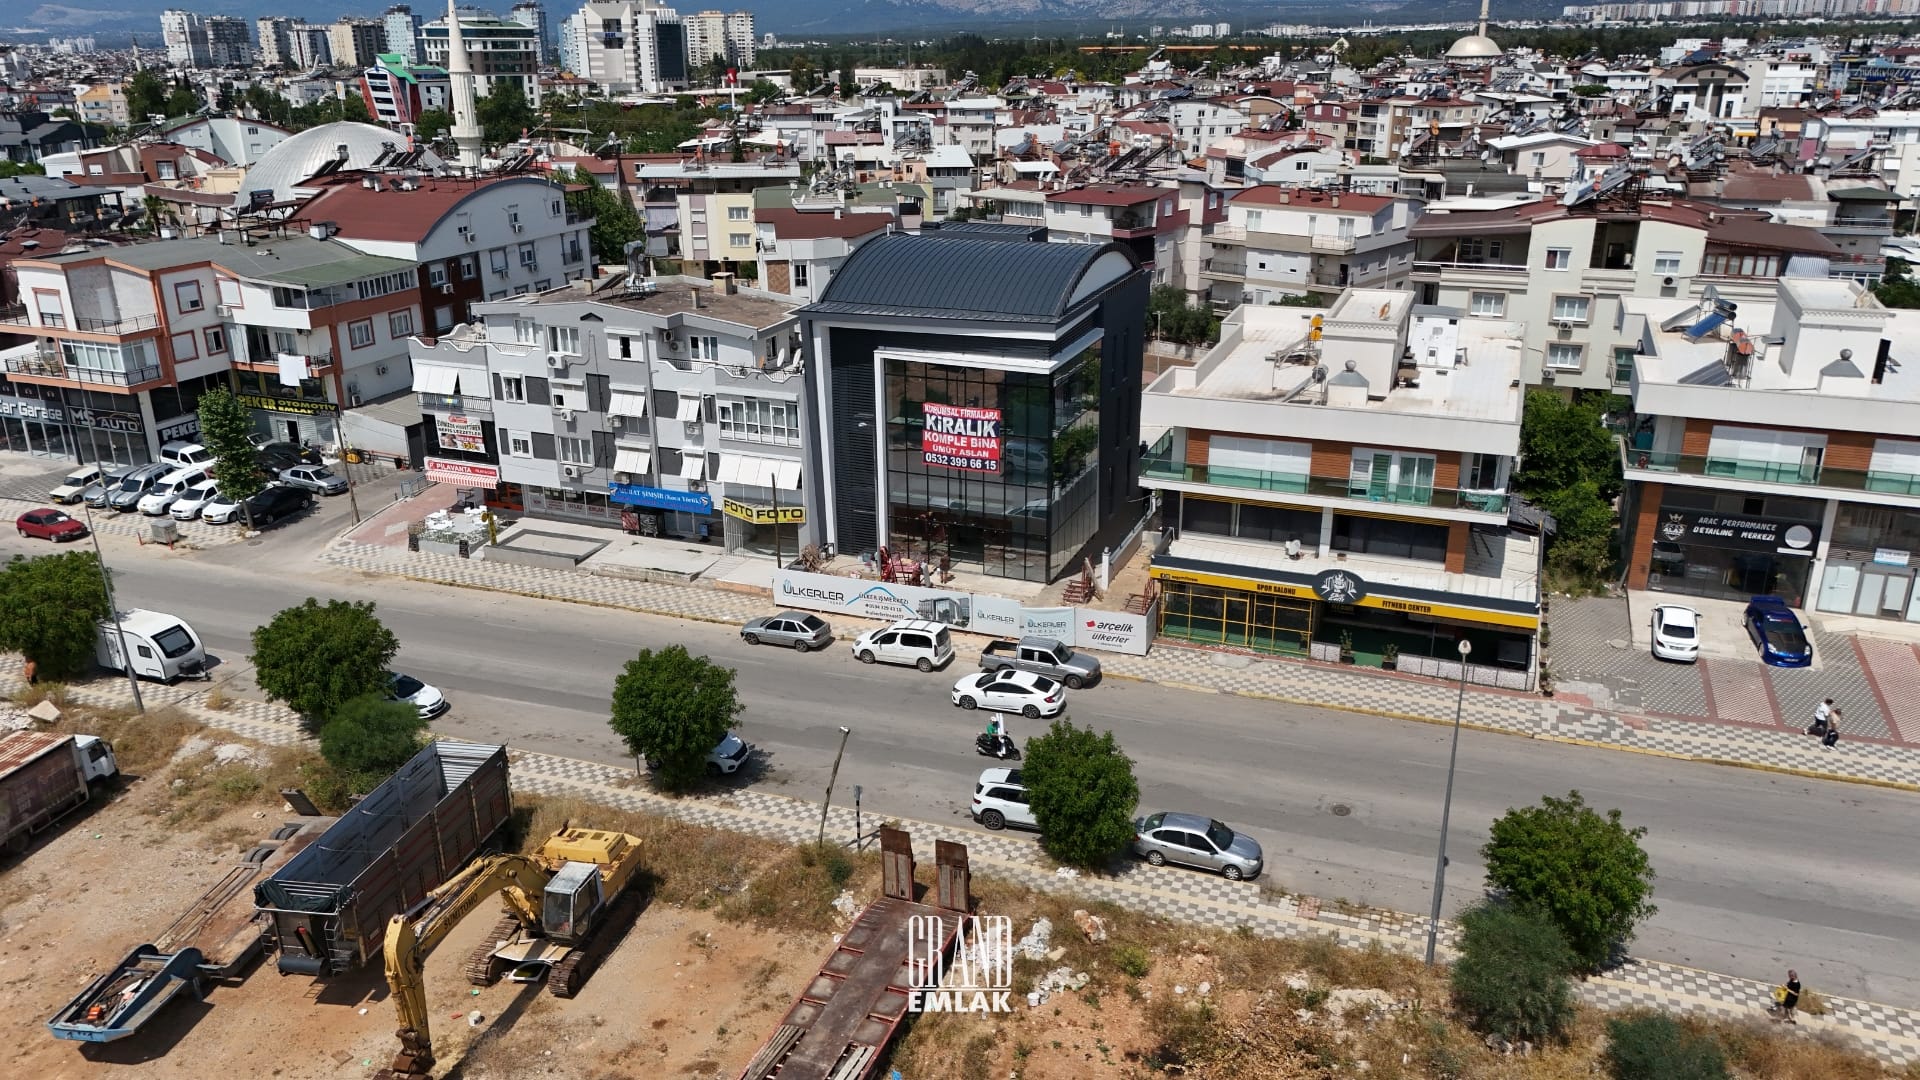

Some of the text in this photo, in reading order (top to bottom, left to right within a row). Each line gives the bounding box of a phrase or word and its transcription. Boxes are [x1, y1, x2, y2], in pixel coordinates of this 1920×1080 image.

[19, 402, 62, 420] Garage
[70, 408, 95, 426] MS
[101, 418, 140, 431] AUTO
[924, 431, 967, 446] KOMPLE
[959, 448, 989, 457] ASLAN
[925, 452, 996, 470] 0532 399 66 15
[724, 499, 753, 517] FOTO
[756, 509, 803, 519] FOTO
[1721, 520, 1778, 531] PERFORMANCE
[1257, 584, 1296, 595] SPOR SALONU
[1408, 604, 1431, 613] CENTER
[1097, 621, 1134, 633] arçelik
[1091, 633, 1130, 643] ülkerler
[444, 893, 478, 930] SUMITOMO
